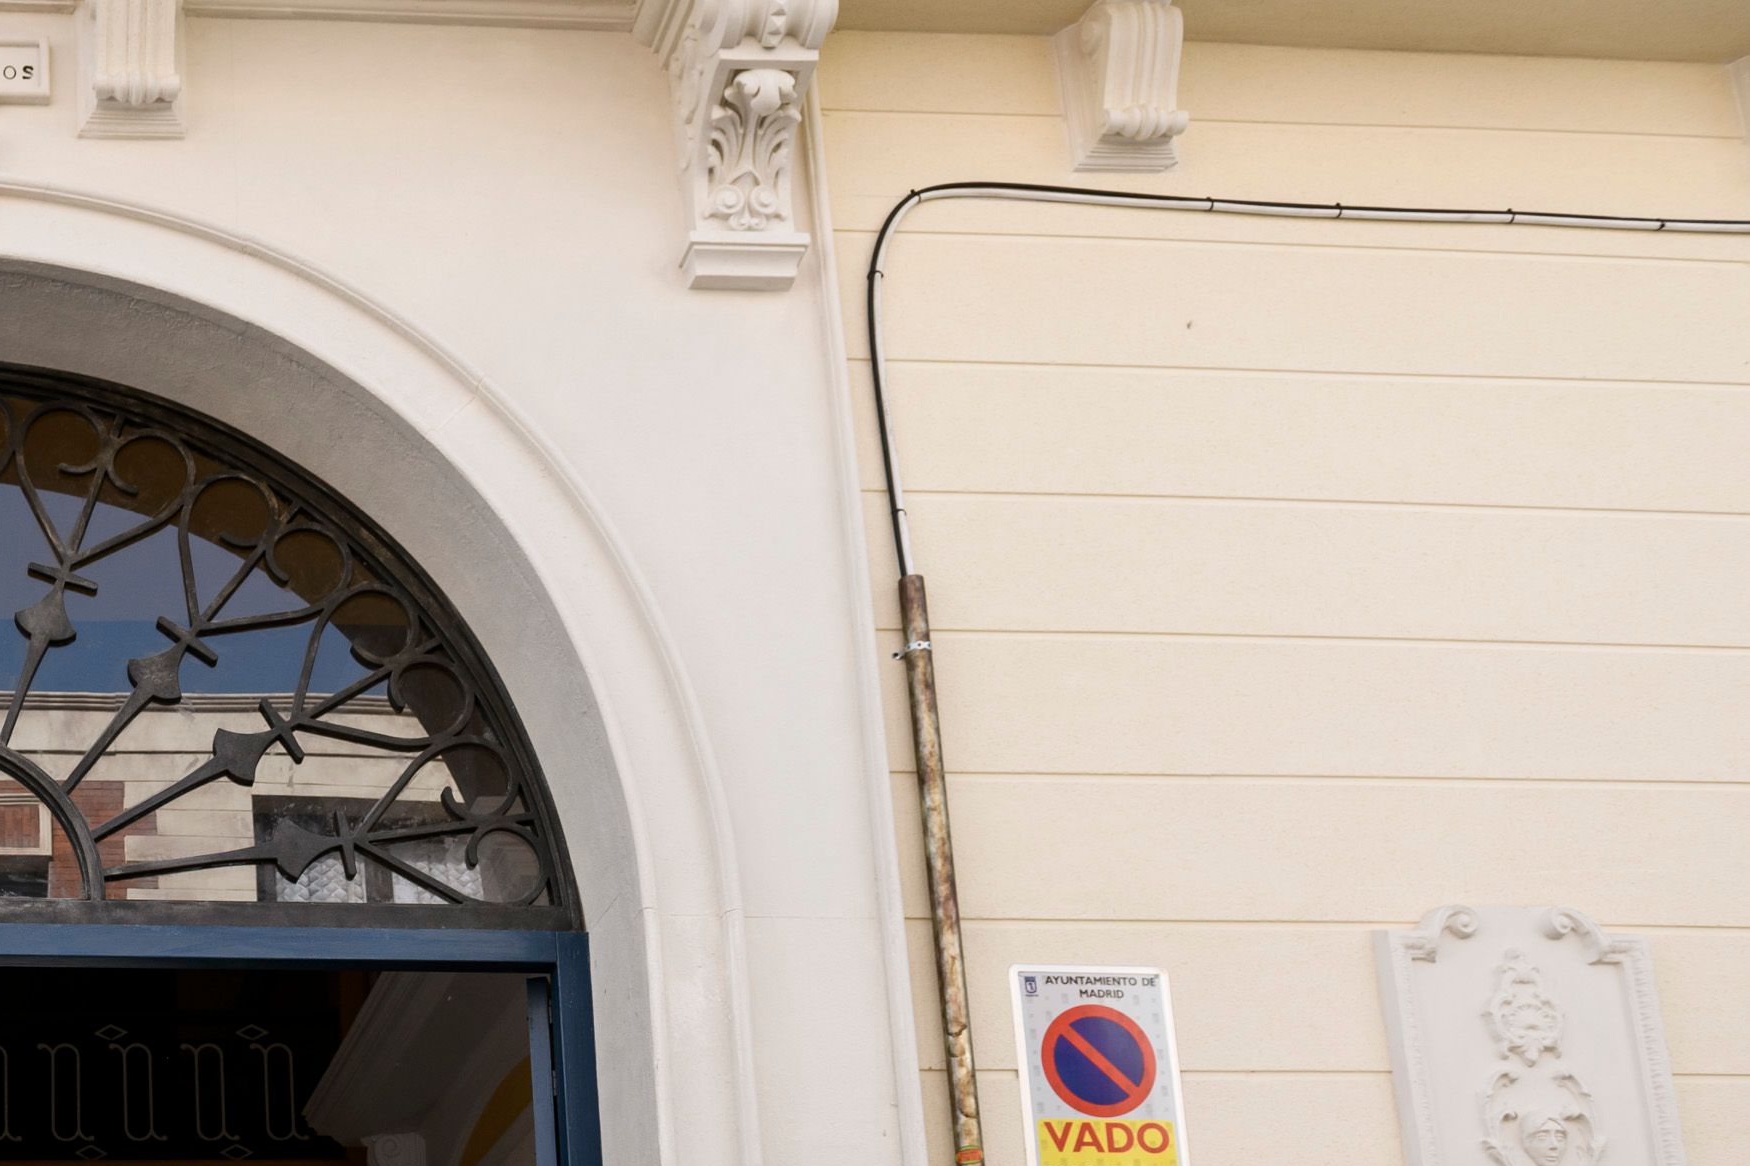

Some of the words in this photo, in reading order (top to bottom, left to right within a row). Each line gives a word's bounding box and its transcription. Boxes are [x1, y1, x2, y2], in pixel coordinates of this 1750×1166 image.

[1045, 975, 1137, 987] AYUNTAMIENTO
[1142, 977, 1156, 987] DE
[1079, 989, 1124, 999] MADRID
[1043, 1121, 1170, 1154] VADO
